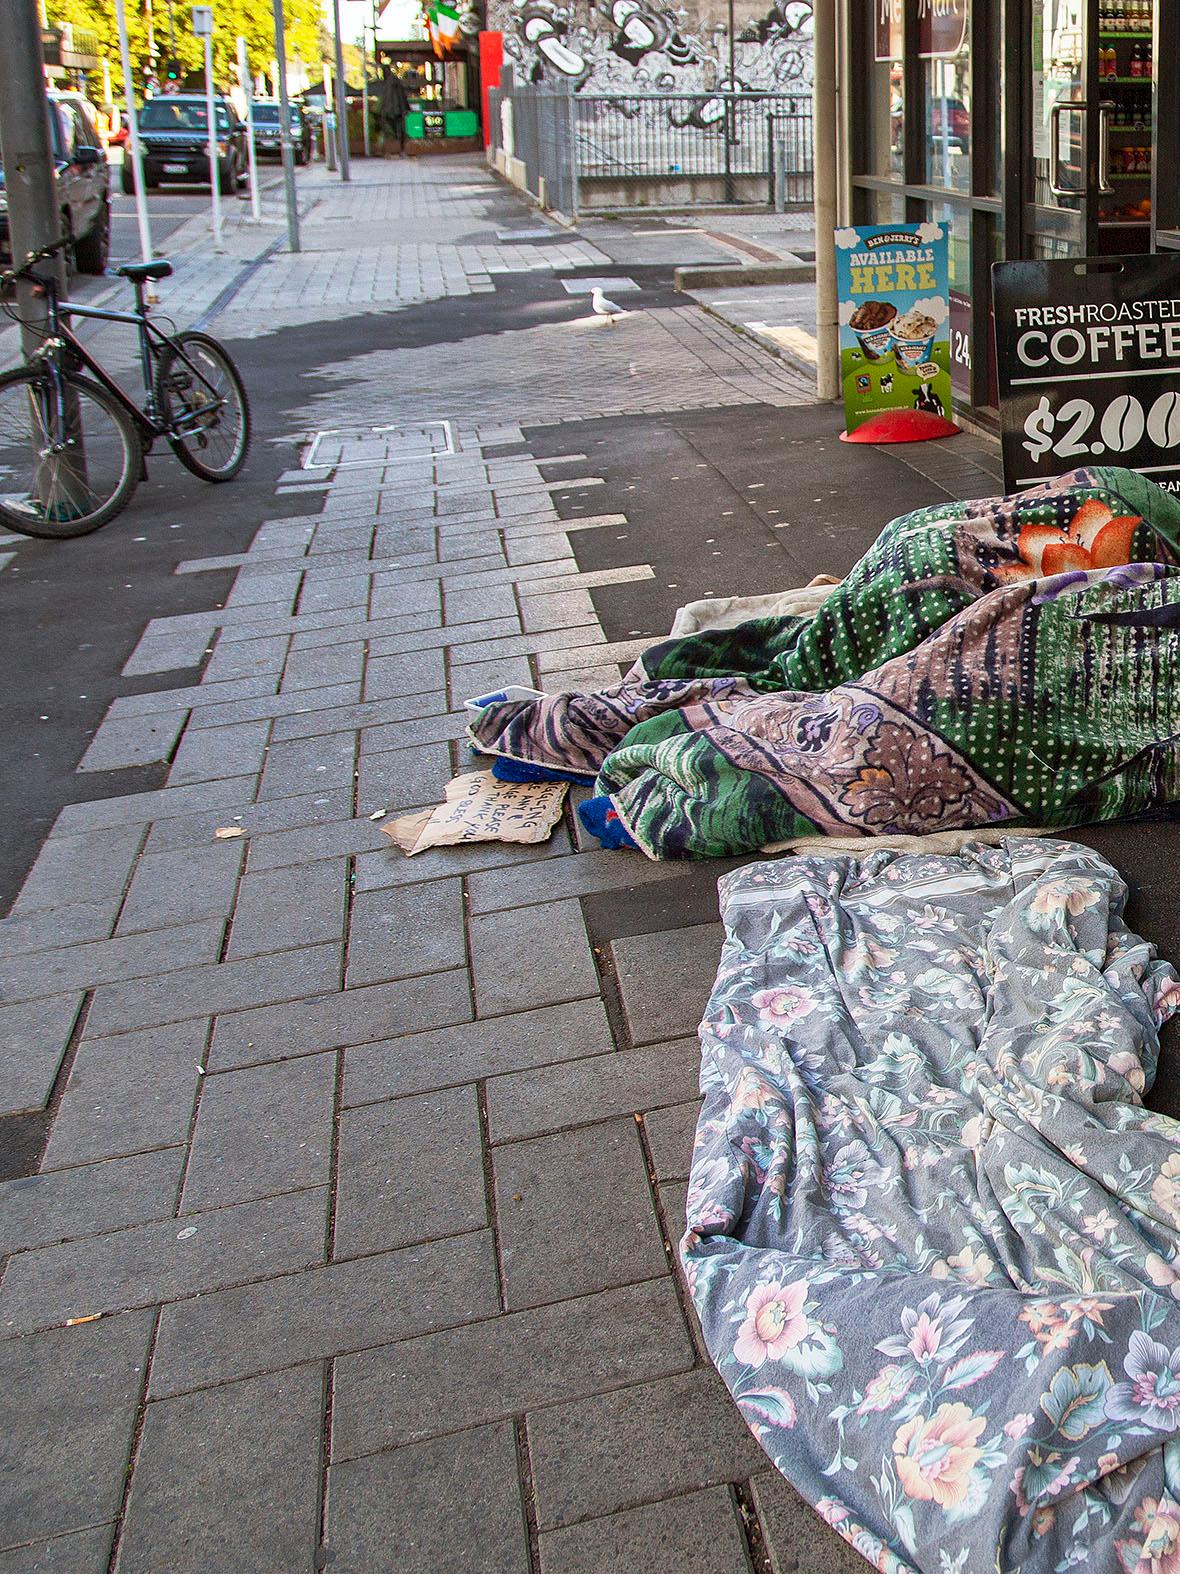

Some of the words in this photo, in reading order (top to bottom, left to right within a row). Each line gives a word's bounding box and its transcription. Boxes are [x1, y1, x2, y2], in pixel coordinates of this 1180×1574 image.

[850, 248, 935, 266] AVAILABLE
[850, 262, 937, 294] HERE
[468, 776, 487, 796] GOD
[472, 792, 500, 819] THANK
[484, 803, 510, 833] PLEASE
